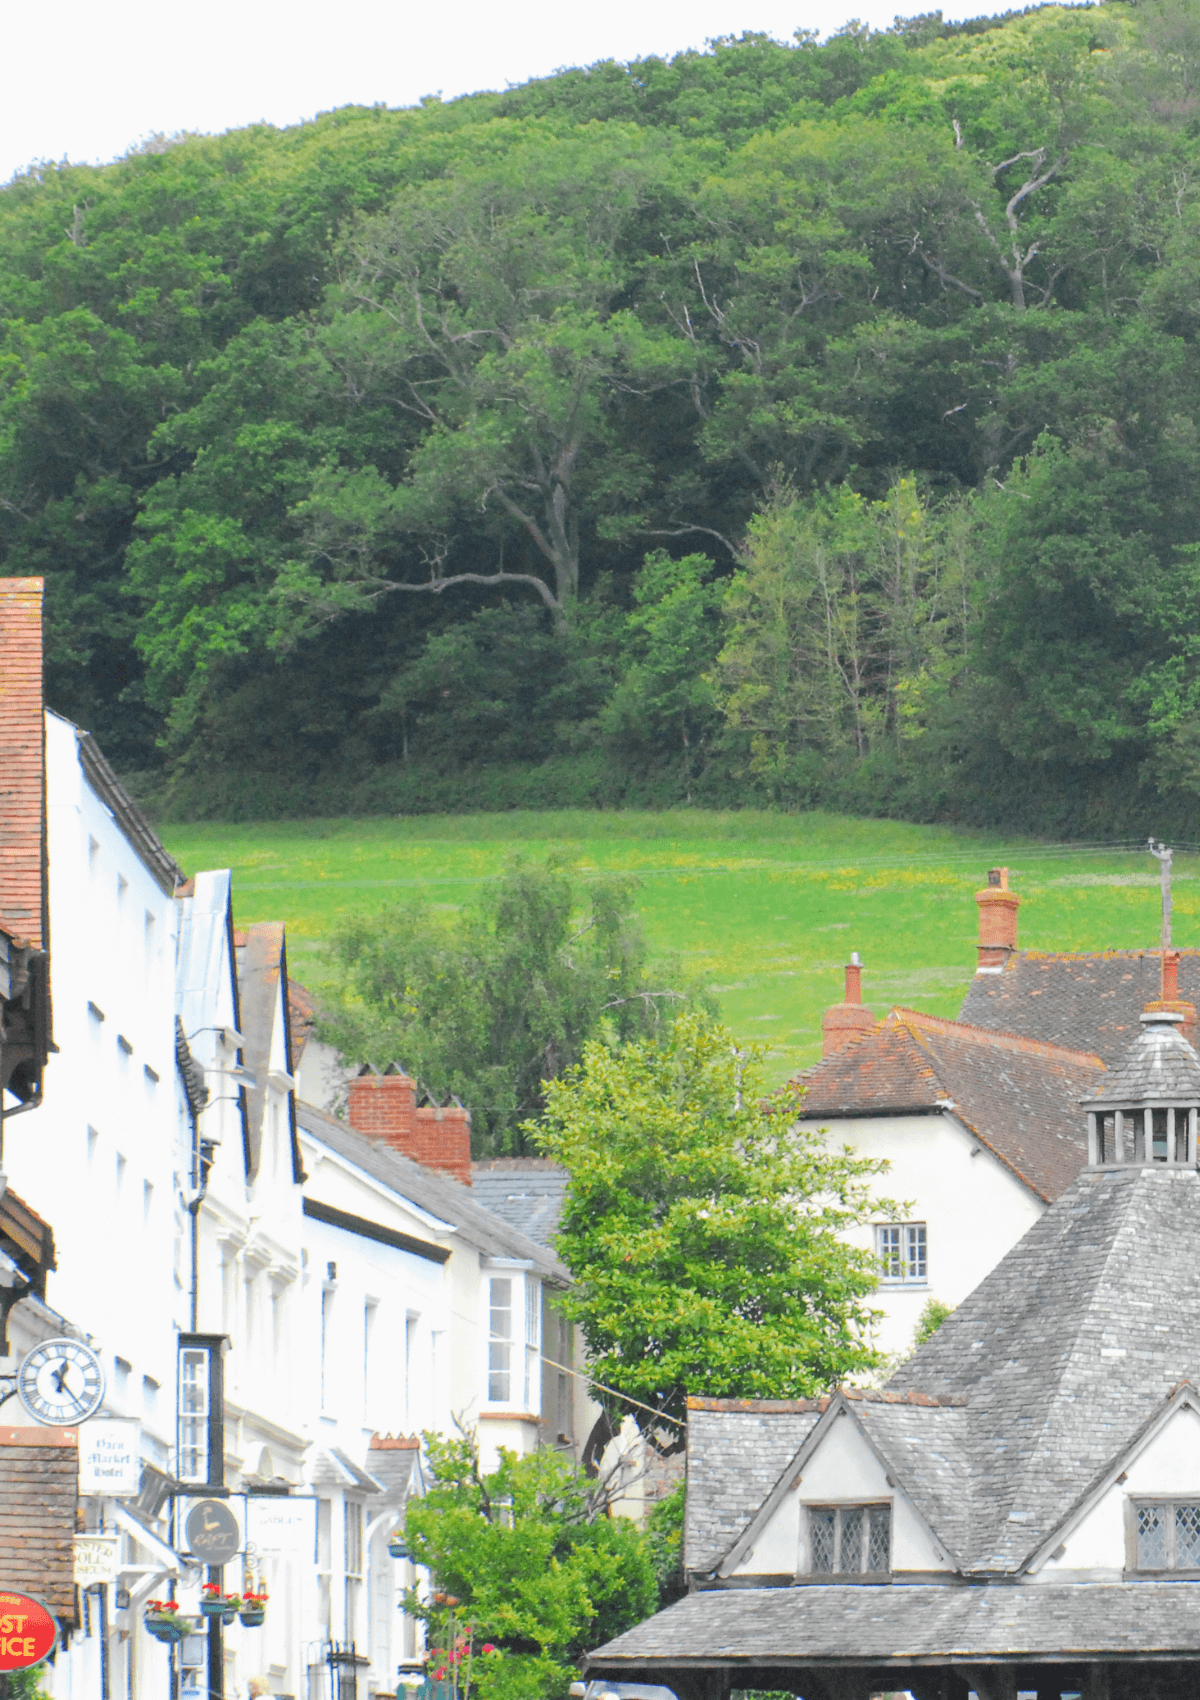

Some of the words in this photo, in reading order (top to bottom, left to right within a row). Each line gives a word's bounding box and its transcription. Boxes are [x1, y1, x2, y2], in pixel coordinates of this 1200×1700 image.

[87, 1453, 130, 1465] Market
[0, 1614, 28, 1634] ST
[0, 1637, 36, 1657] ICE
